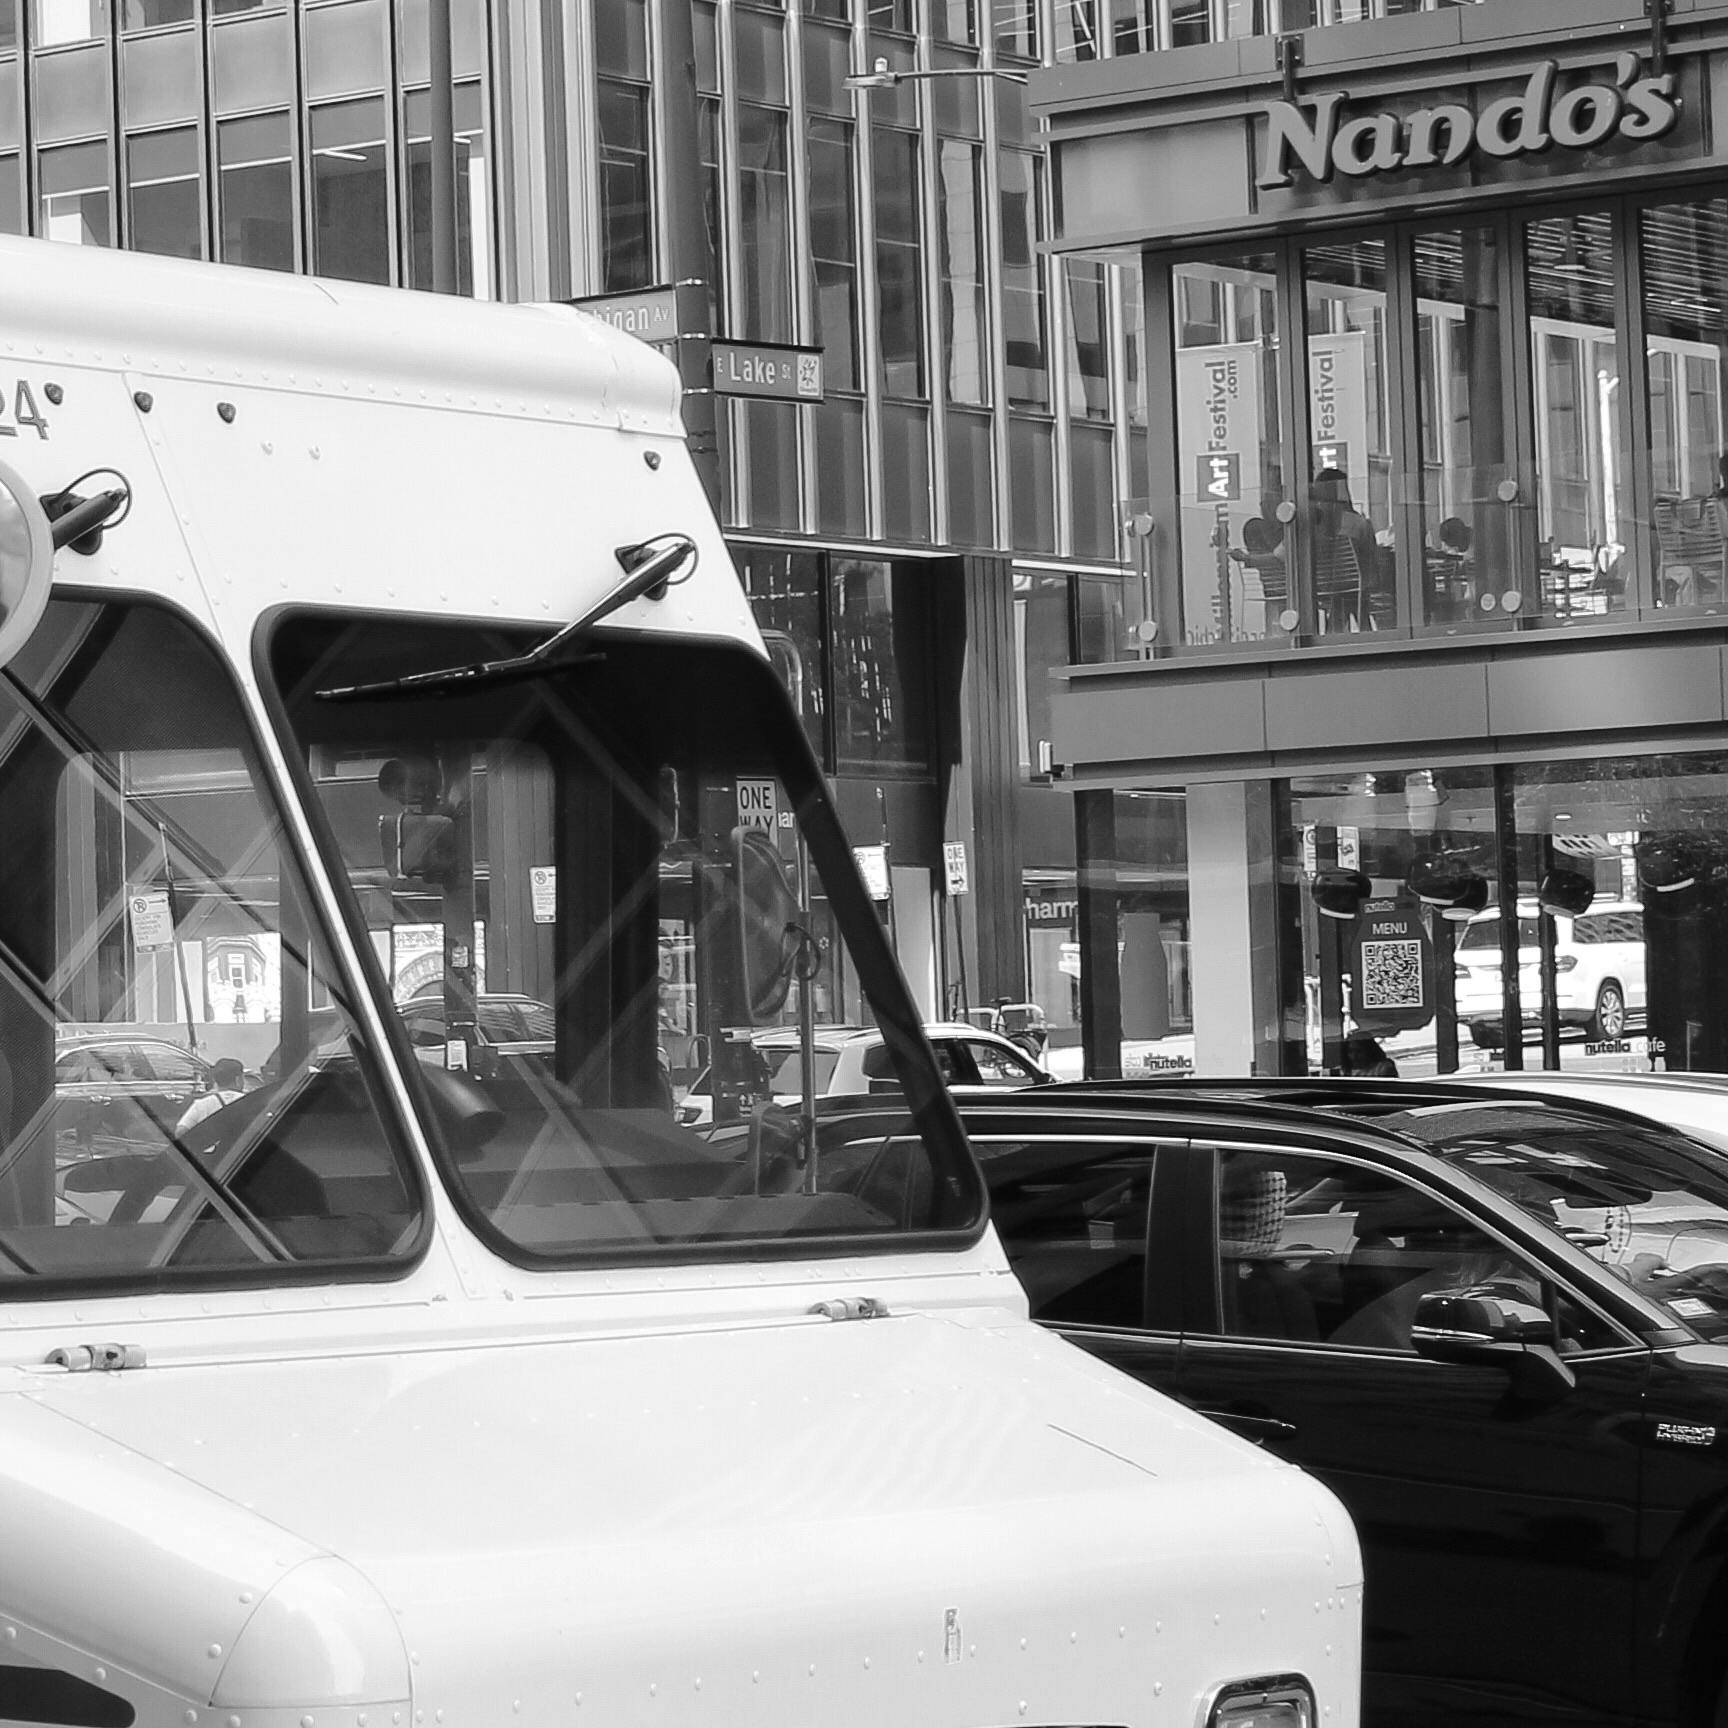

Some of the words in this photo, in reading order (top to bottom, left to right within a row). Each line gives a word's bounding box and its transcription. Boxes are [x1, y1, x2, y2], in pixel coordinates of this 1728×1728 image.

[1255, 50, 1675, 190] Nando's
[717, 357, 724, 373] E
[730, 352, 776, 385] Lake
[1227, 359, 1238, 400] .com
[1204, 360, 1227, 453] Festival
[1311, 350, 1336, 443] Festival
[1319, 447, 1337, 470] rt
[739, 785, 773, 810] ONE
[1372, 921, 1408, 935] MENU
[1585, 1038, 1632, 1057] nutella
